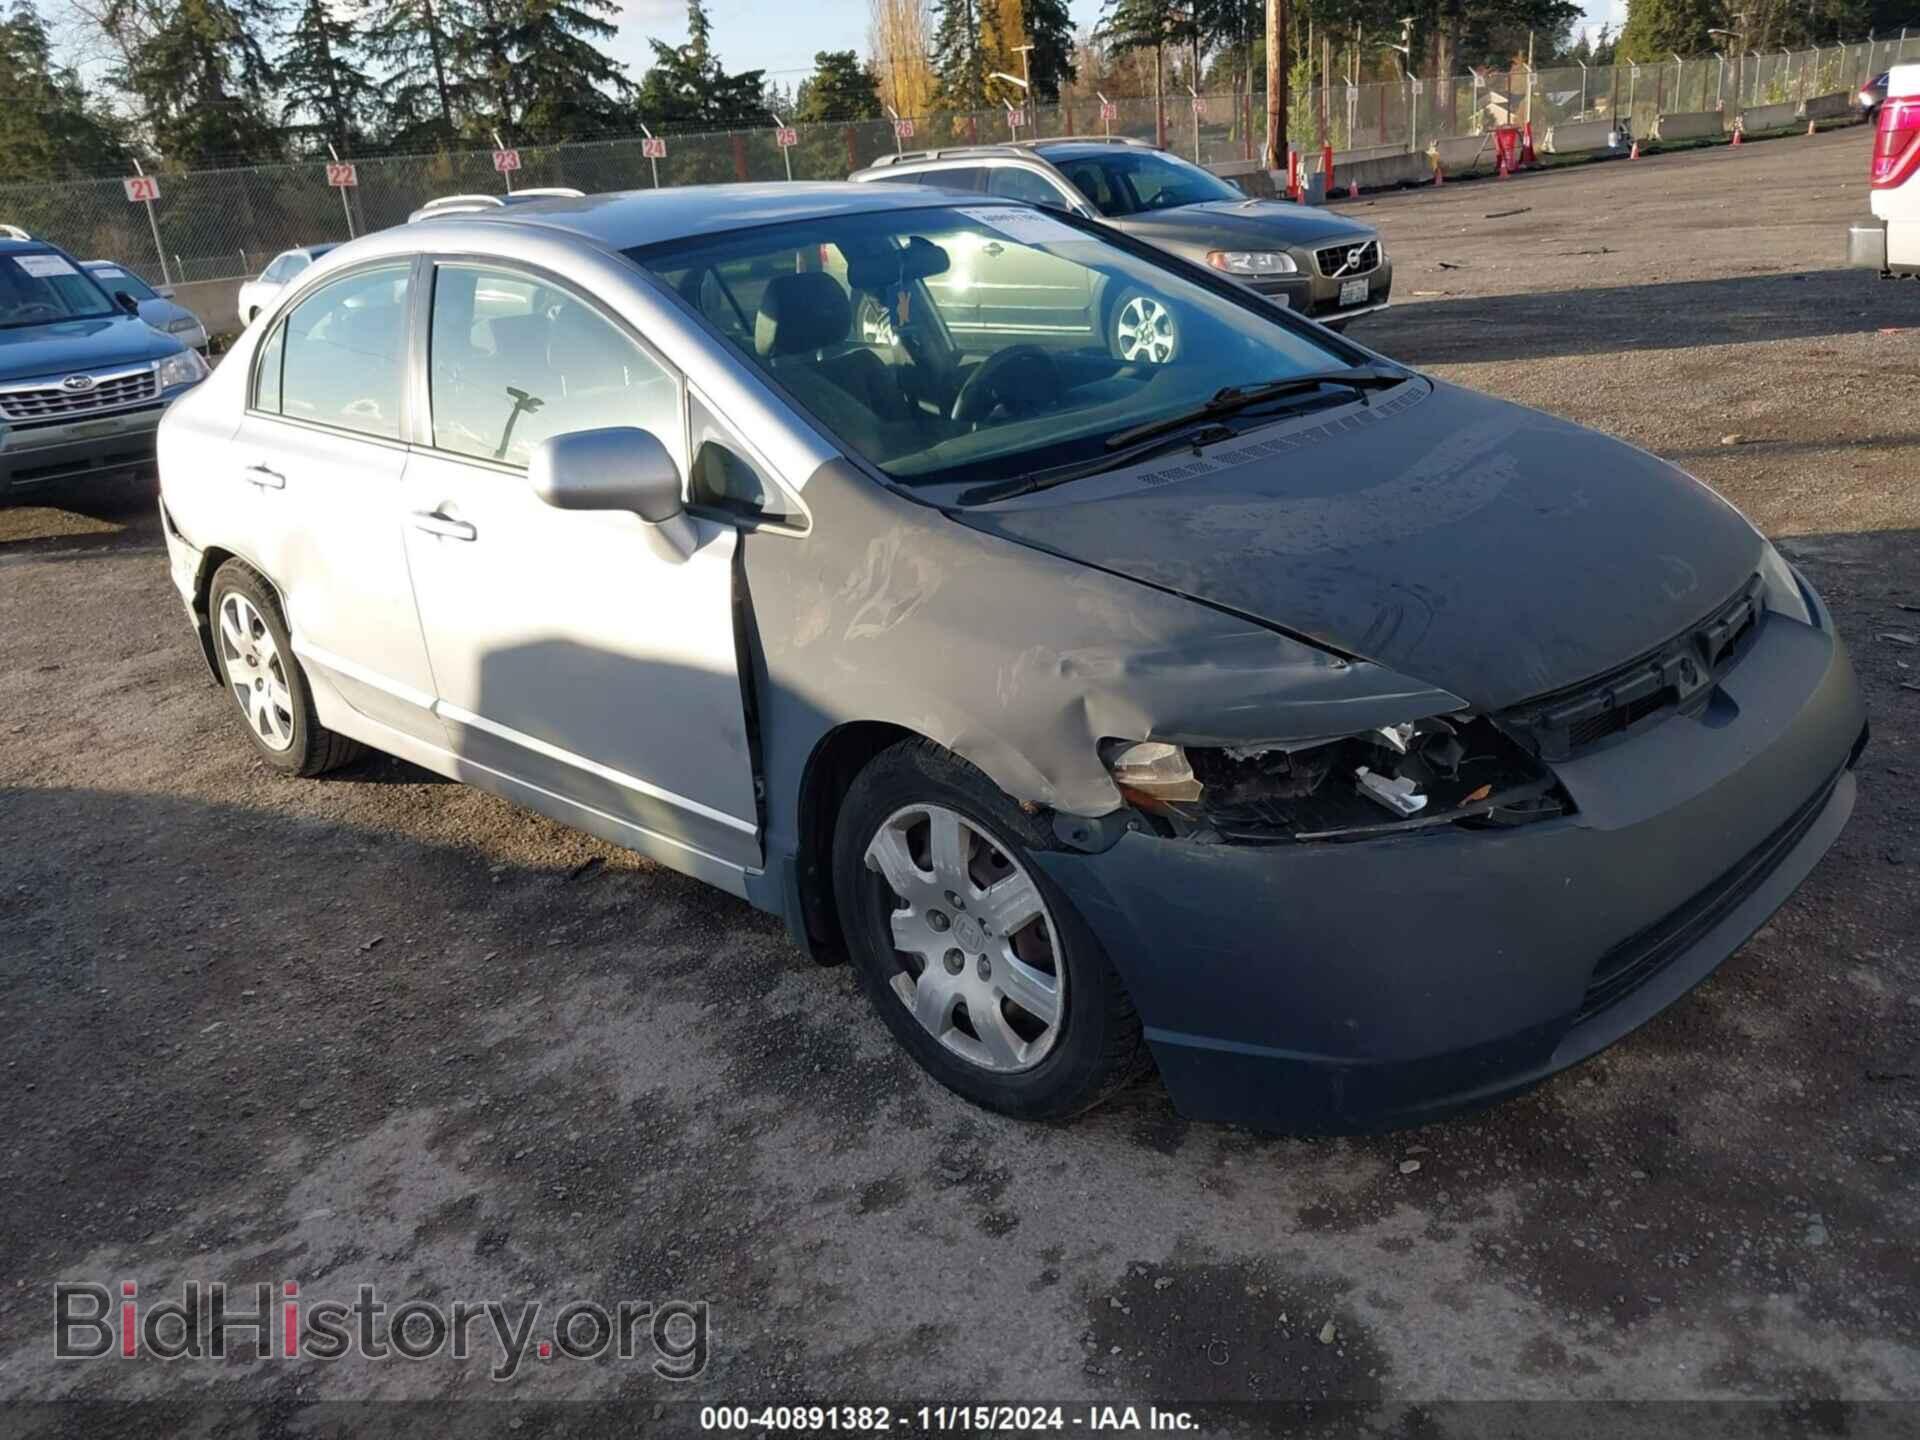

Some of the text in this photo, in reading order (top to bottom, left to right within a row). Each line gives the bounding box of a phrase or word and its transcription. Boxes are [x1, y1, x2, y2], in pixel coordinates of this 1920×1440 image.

[778, 128, 795, 145] 25
[896, 122, 912, 137] 26
[644, 140, 663, 156] 24
[495, 151, 517, 170] 23
[330, 166, 353, 185] 22
[131, 179, 154, 200] 21
